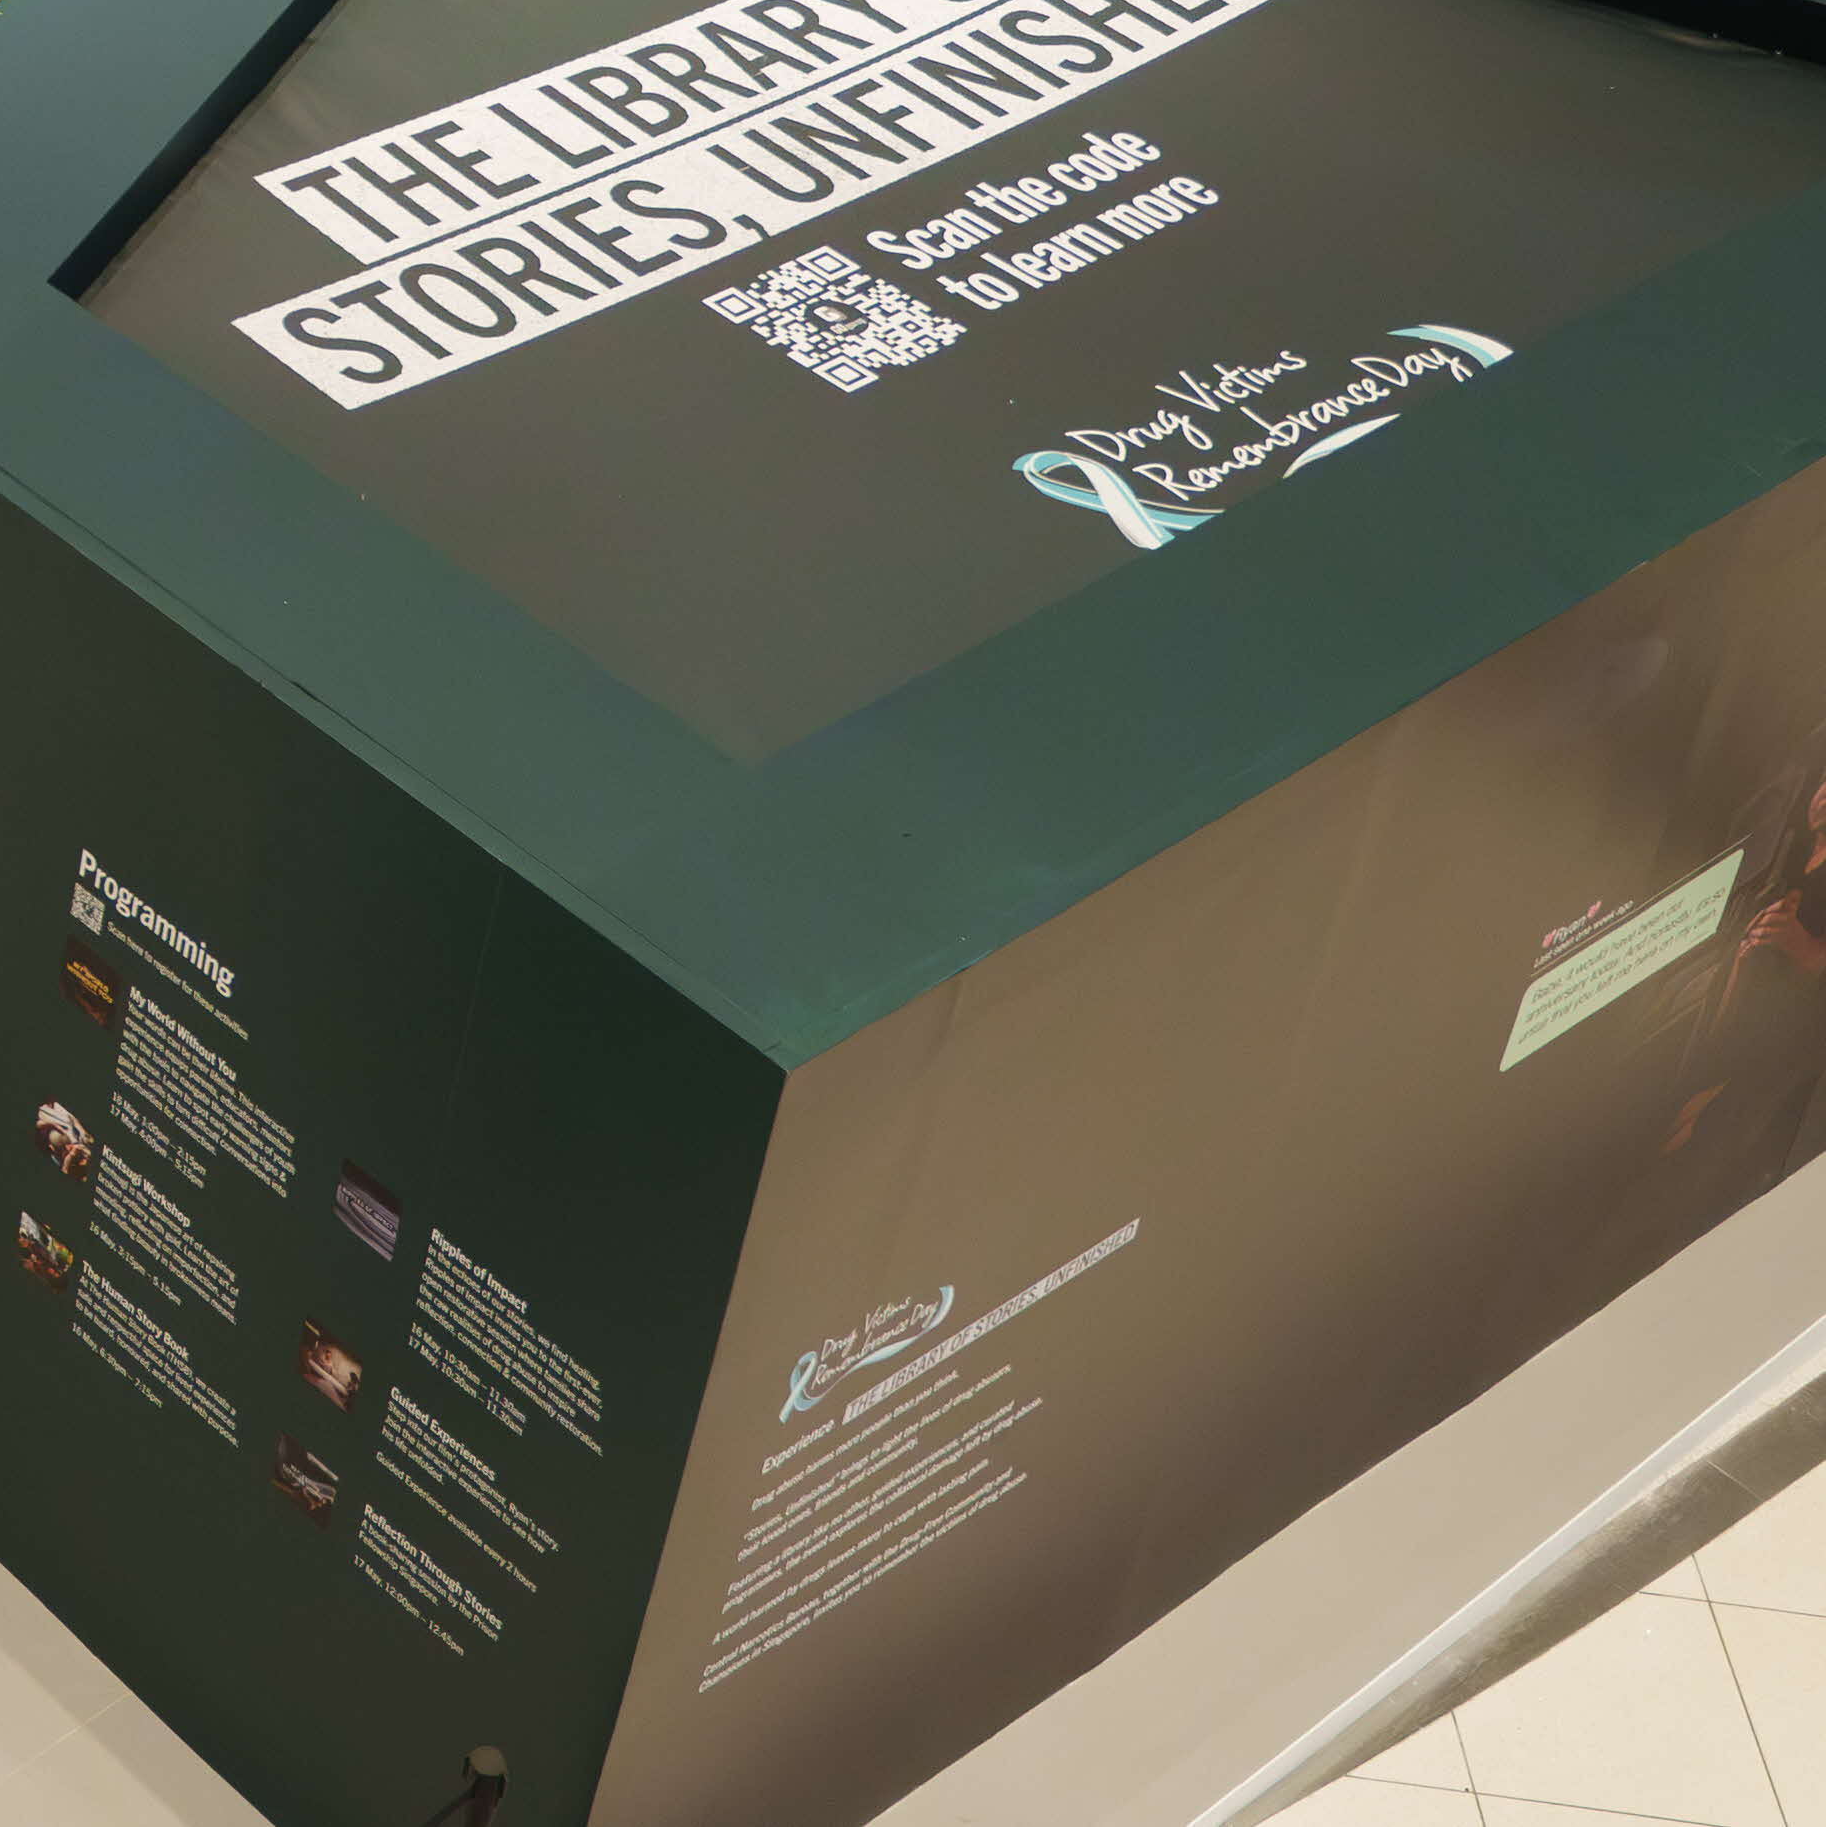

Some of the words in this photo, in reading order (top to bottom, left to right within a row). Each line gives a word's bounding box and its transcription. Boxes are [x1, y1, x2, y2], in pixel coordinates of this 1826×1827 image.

[283, 120, 541, 243] THE
[866, 206, 990, 271] Scan
[972, 171, 1067, 225] the
[1047, 129, 1161, 193] code
[936, 270, 1019, 311] to
[981, 223, 1123, 290] learn
[1097, 175, 1220, 242] more
[283, 180, 770, 384] STORIES,
[1065, 408, 1213, 462] Drug
[1155, 349, 1307, 413] Victims
[1132, 380, 1390, 502] Remembrance
[1350, 347, 1474, 383] Day
[79, 849, 234, 997] Programming
[107, 922, 126, 942] Scan
[144, 951, 153, 963] to
[214, 1009, 248, 1040] activities
[130, 986, 146, 1008] My
[148, 999, 176, 1031] World
[178, 1024, 216, 1065] Without
[218, 1057, 236, 1081] You
[103, 1145, 142, 1186] Kintsugi
[144, 1179, 190, 1227] Workshop
[83, 1260, 100, 1284] The
[102, 1278, 135, 1314] Human
[136, 1308, 162, 1338] Story
[164, 1332, 189, 1361] Book
[432, 1229, 472, 1269] Ripples
[474, 1266, 486, 1280] of
[487, 1274, 527, 1314] Impact
[820, 1330, 857, 1362] Drug
[864, 1296, 911, 1334] Victims
[910, 1301, 939, 1328] Day
[761, 1420, 835, 1474] Experience
[849, 1386, 884, 1420] THE
[881, 1346, 949, 1400] LIBRARY
[949, 1331, 973, 1355] OF
[1043, 1224, 1137, 1293] UNFINISHED
[391, 1387, 428, 1425] Guided
[430, 1419, 495, 1481] Experiences
[752, 1490, 775, 1511] Drug
[776, 1471, 804, 1495] abuse
[805, 1451, 834, 1475] harms
[836, 1435, 860, 1456] more
[860, 1413, 892, 1441] people
[893, 1399, 915, 1417] than
[913, 1387, 932, 1406] you
[365, 1504, 417, 1557] Reflection
[420, 1550, 462, 1596] Through
[464, 1590, 502, 1629] Stories
[377, 1452, 404, 1479] Guided
[405, 1475, 447, 1516] Experience
[448, 1514, 482, 1547] available
[484, 1544, 506, 1567] every
[506, 1561, 513, 1572] 2
[513, 1567, 536, 1592] hours
